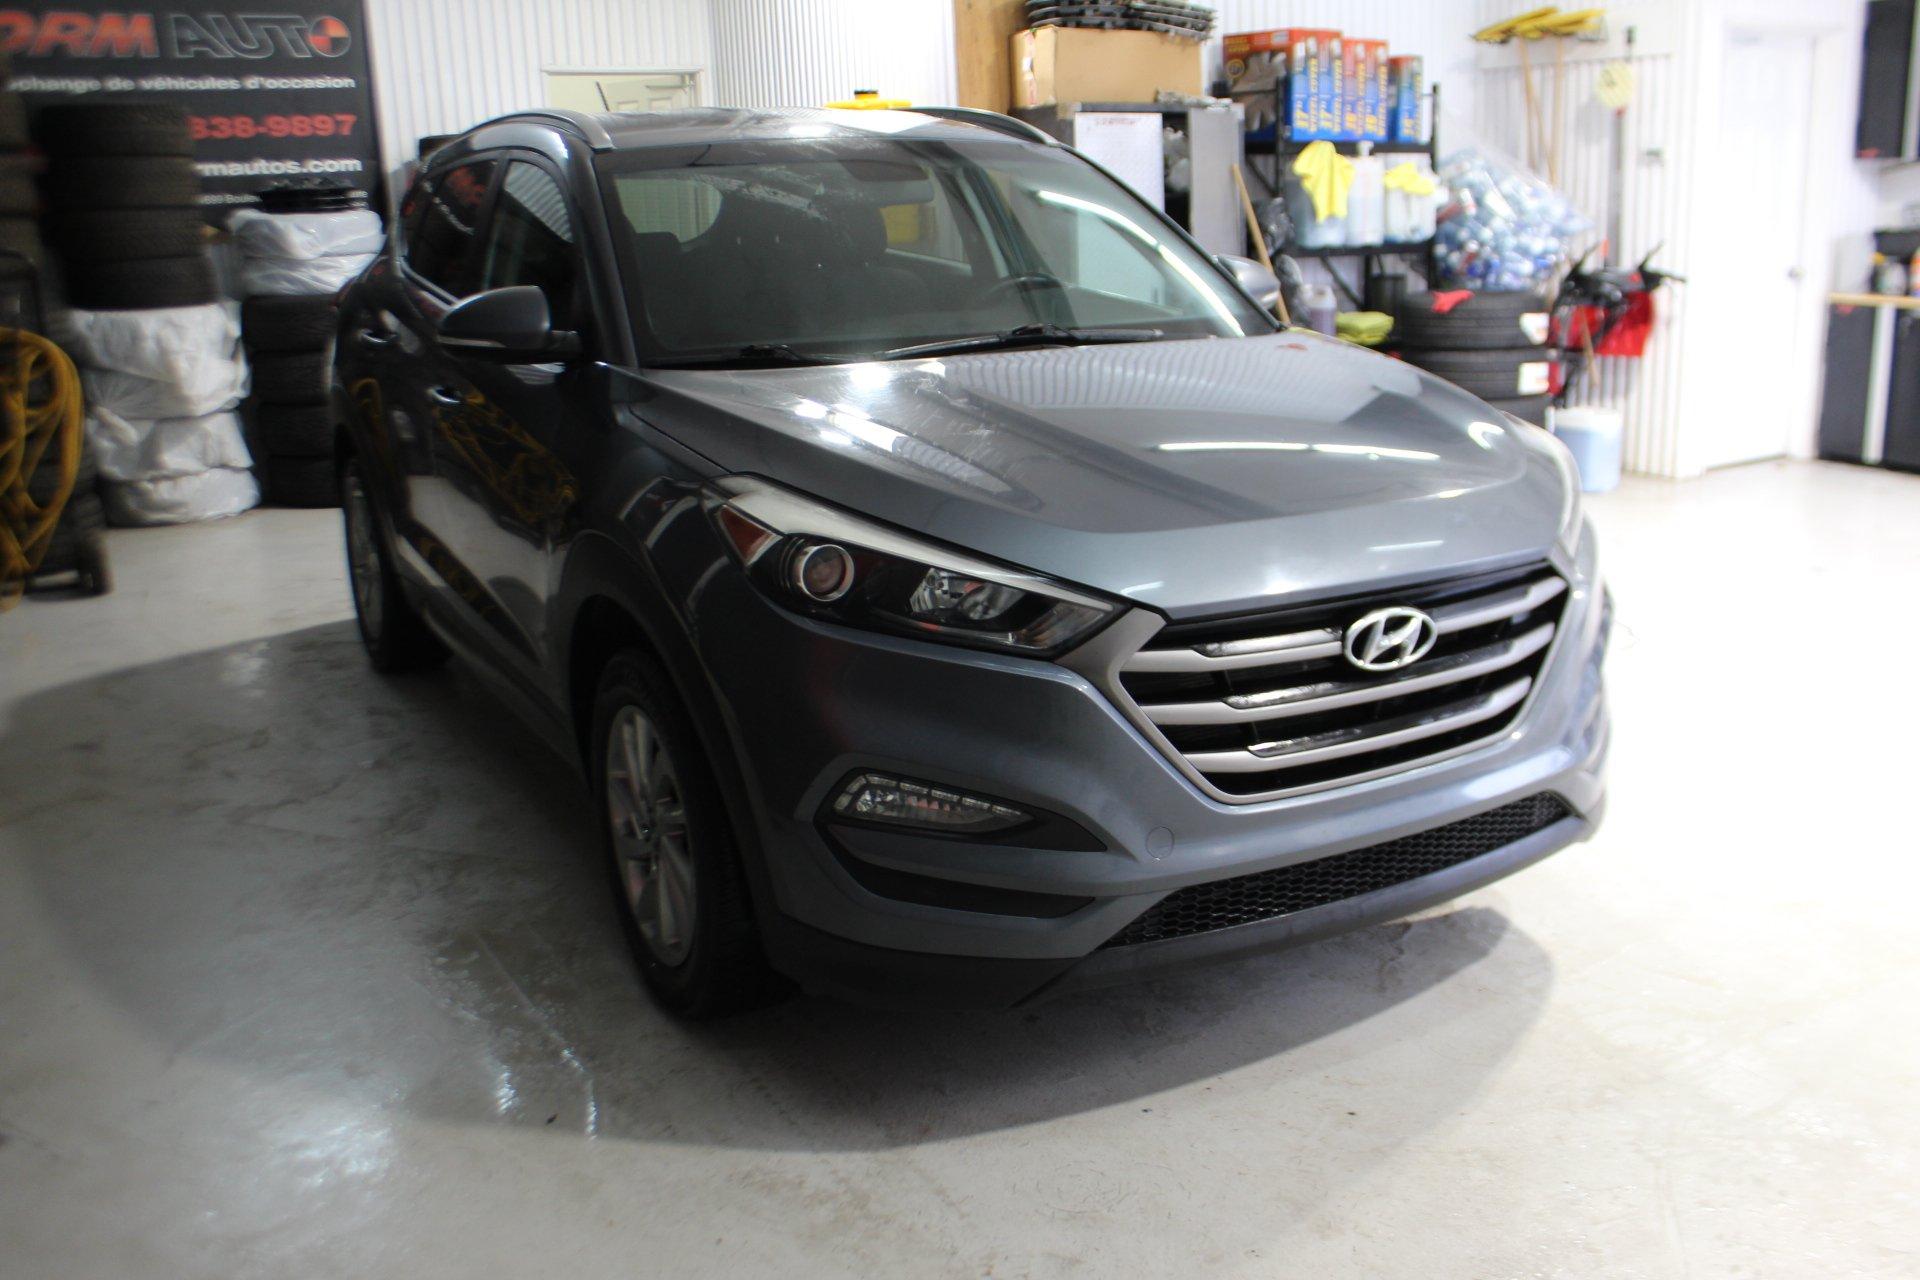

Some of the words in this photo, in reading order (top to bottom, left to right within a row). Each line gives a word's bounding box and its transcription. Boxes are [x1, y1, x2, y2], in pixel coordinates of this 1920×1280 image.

[168, 13, 350, 59] AUTO
[104, 76, 135, 91] de
[142, 75, 241, 91] véhicules
[247, 75, 357, 90] d'occasion
